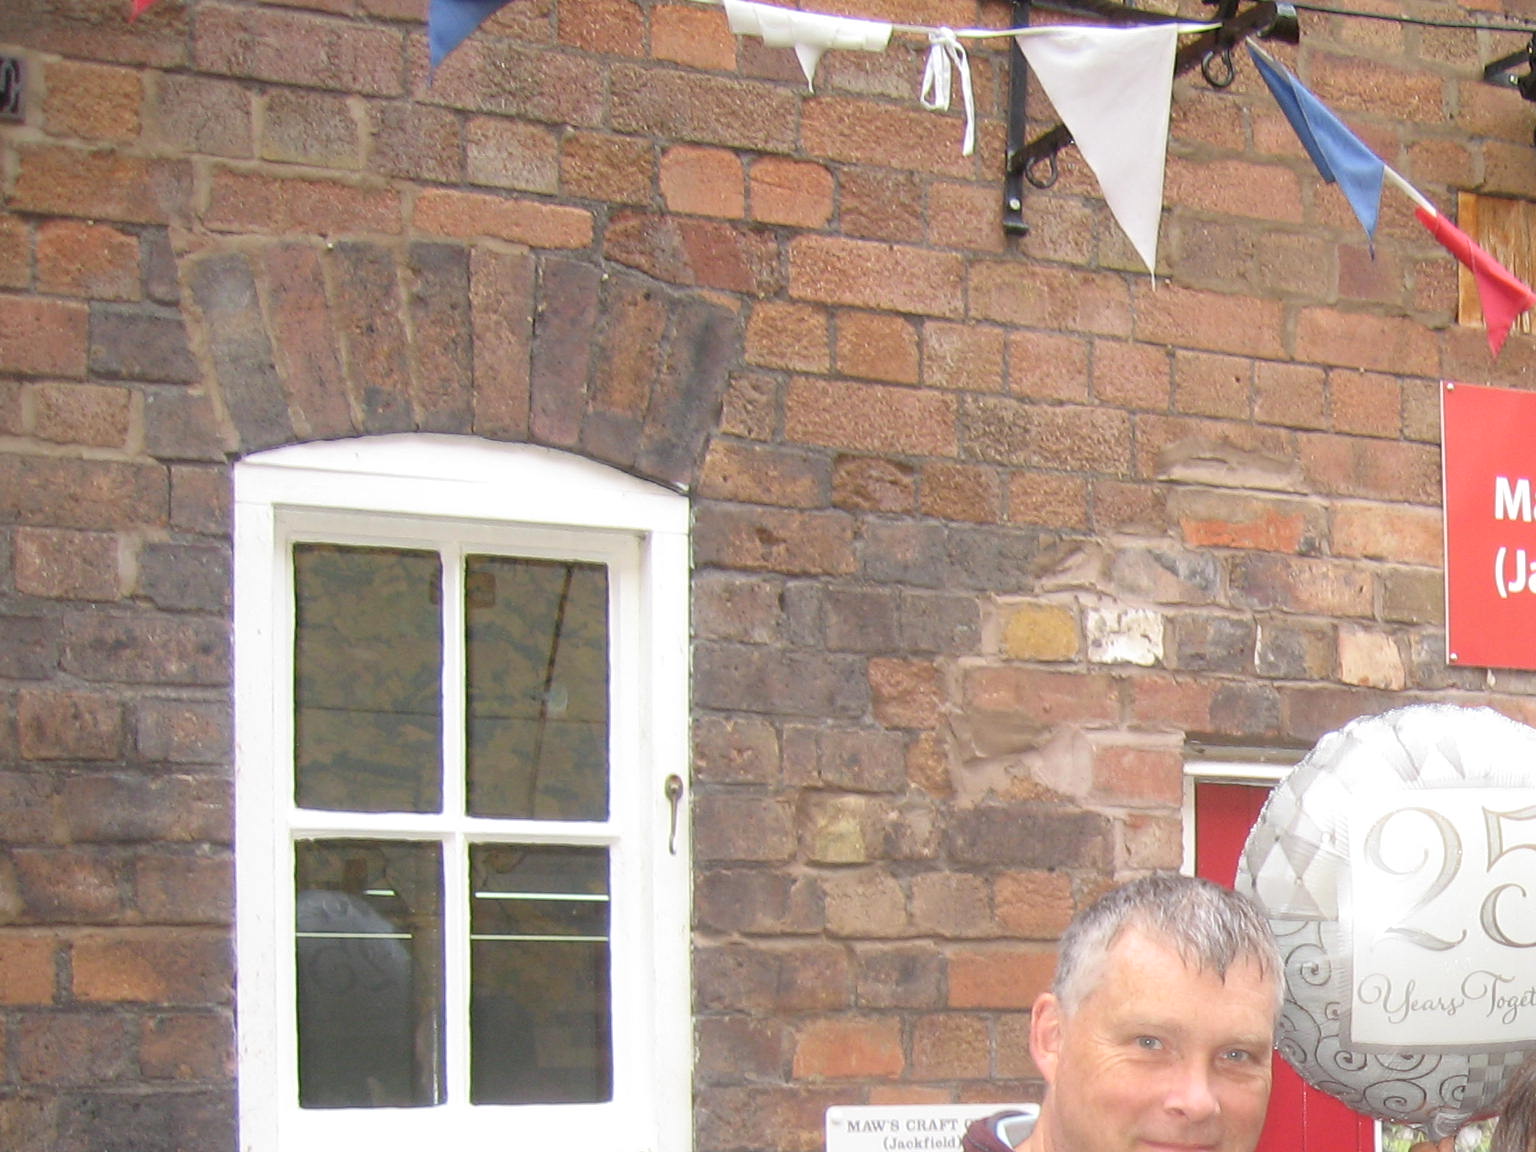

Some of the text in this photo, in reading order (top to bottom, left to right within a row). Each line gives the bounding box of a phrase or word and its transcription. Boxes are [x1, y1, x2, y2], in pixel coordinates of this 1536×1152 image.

[1358, 972, 1464, 1024] Years
[846, 1119, 900, 1133] MAW'S
[905, 1117, 959, 1132] CRAFT
[882, 1135, 963, 1152] (Jackfield)
